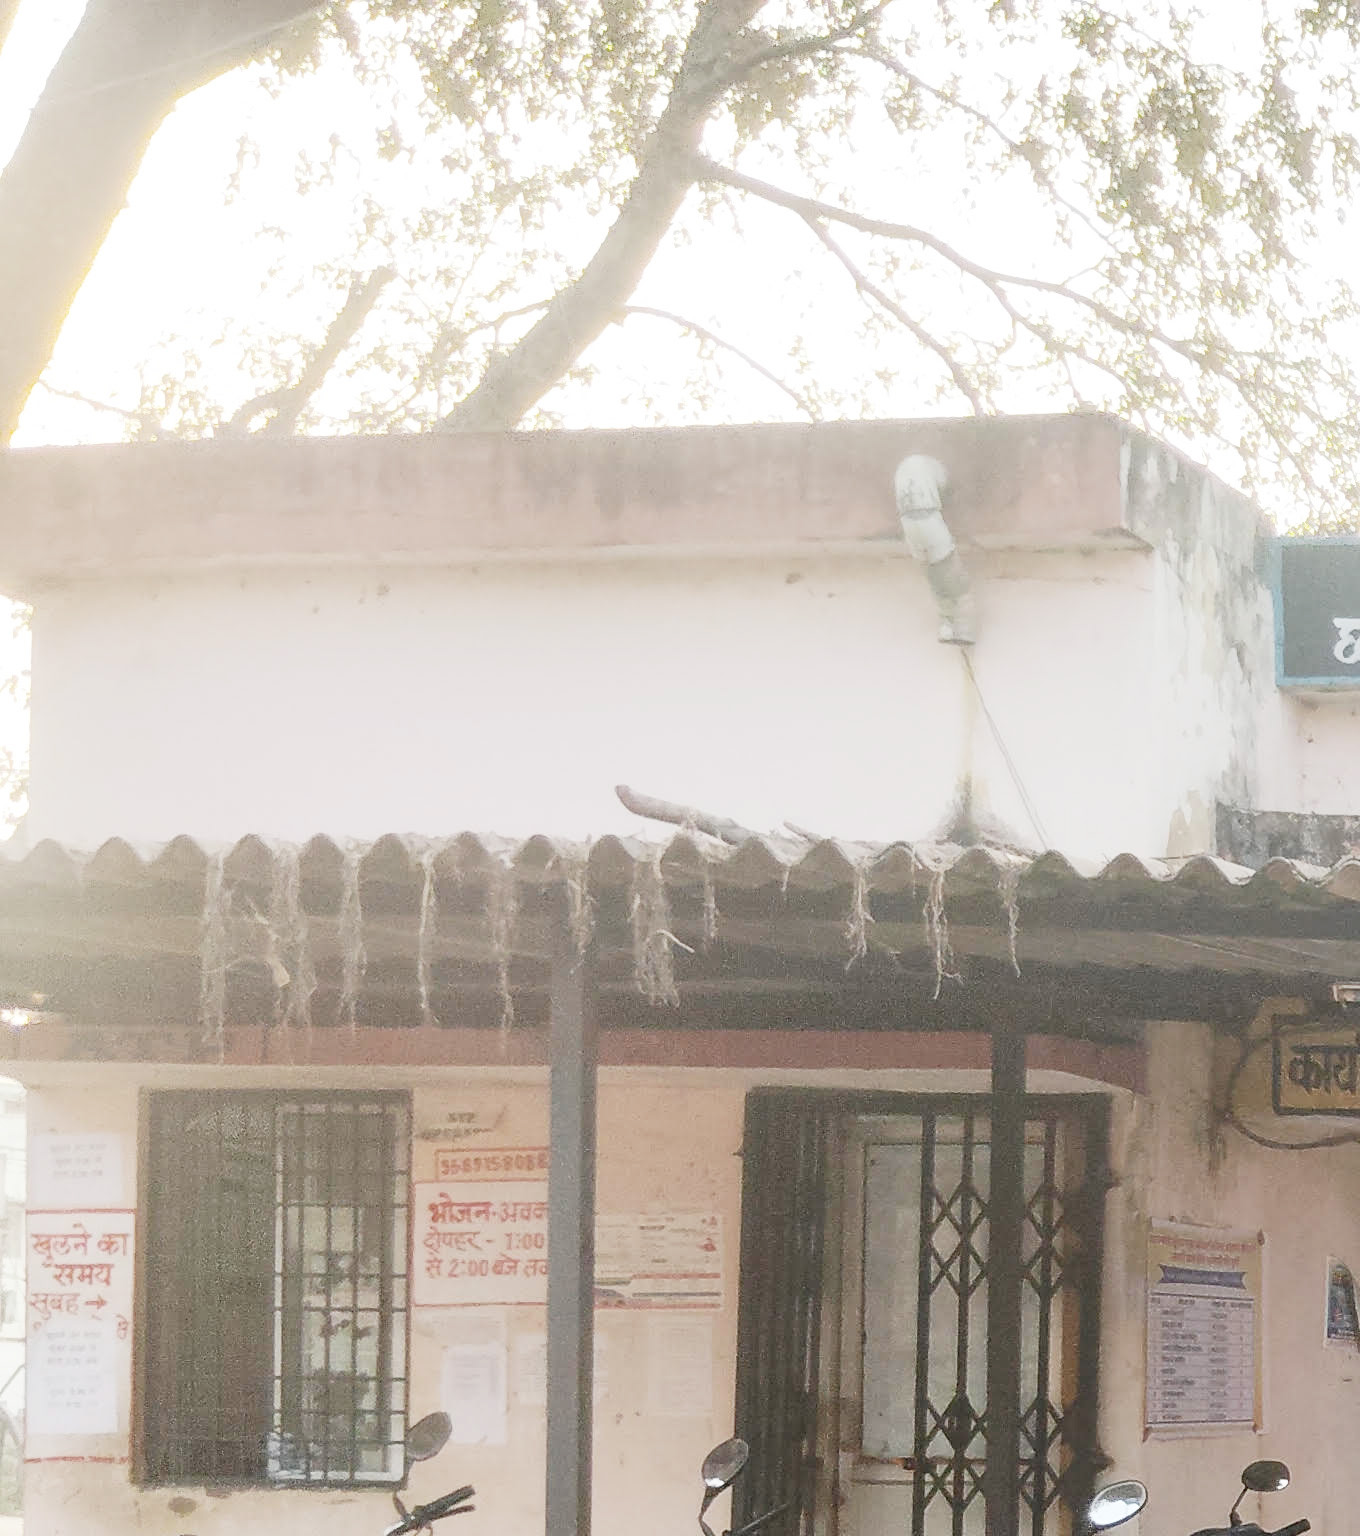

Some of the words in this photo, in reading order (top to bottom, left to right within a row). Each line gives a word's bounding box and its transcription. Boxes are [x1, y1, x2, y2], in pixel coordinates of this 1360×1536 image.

[97, 1233, 130, 1257] का
[52, 1263, 116, 1287] समय
[28, 1292, 81, 1322] सुबह
